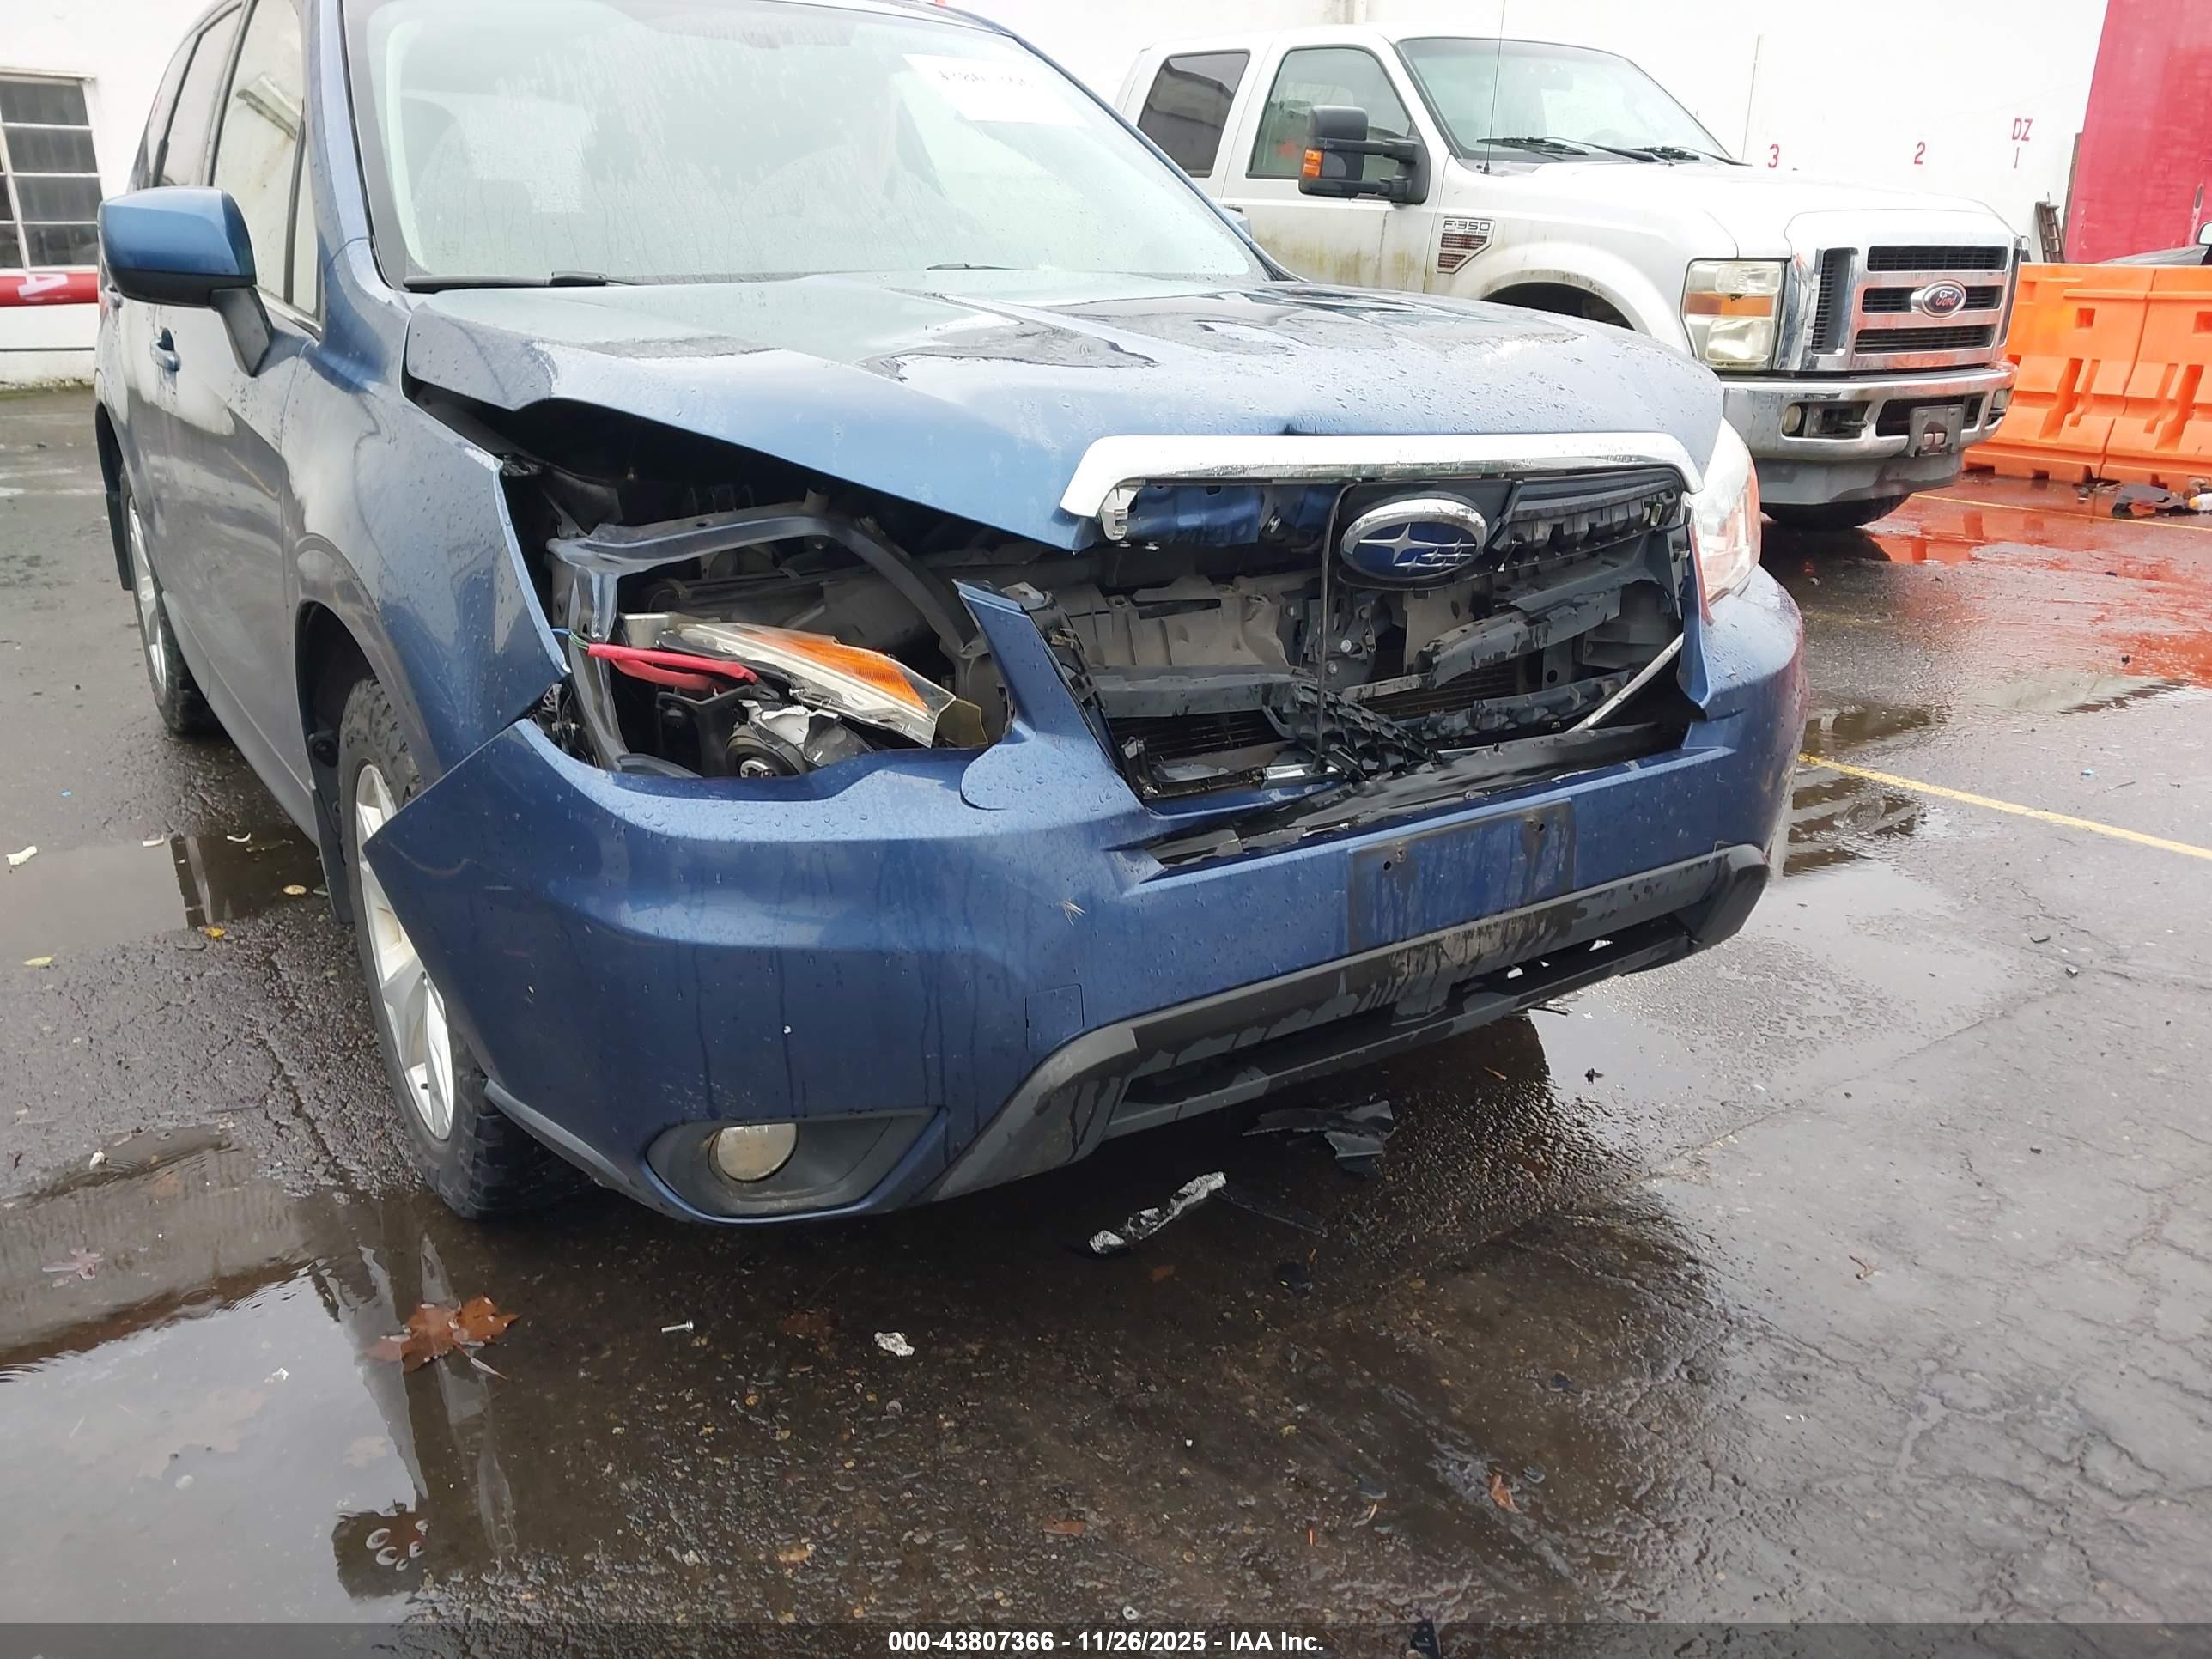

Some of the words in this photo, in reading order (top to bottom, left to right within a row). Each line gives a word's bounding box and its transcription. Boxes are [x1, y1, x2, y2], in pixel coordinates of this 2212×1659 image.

[1767, 143, 1780, 168] 3
[1913, 141, 1926, 165] 2
[1936, 290, 1958, 307] Ford
